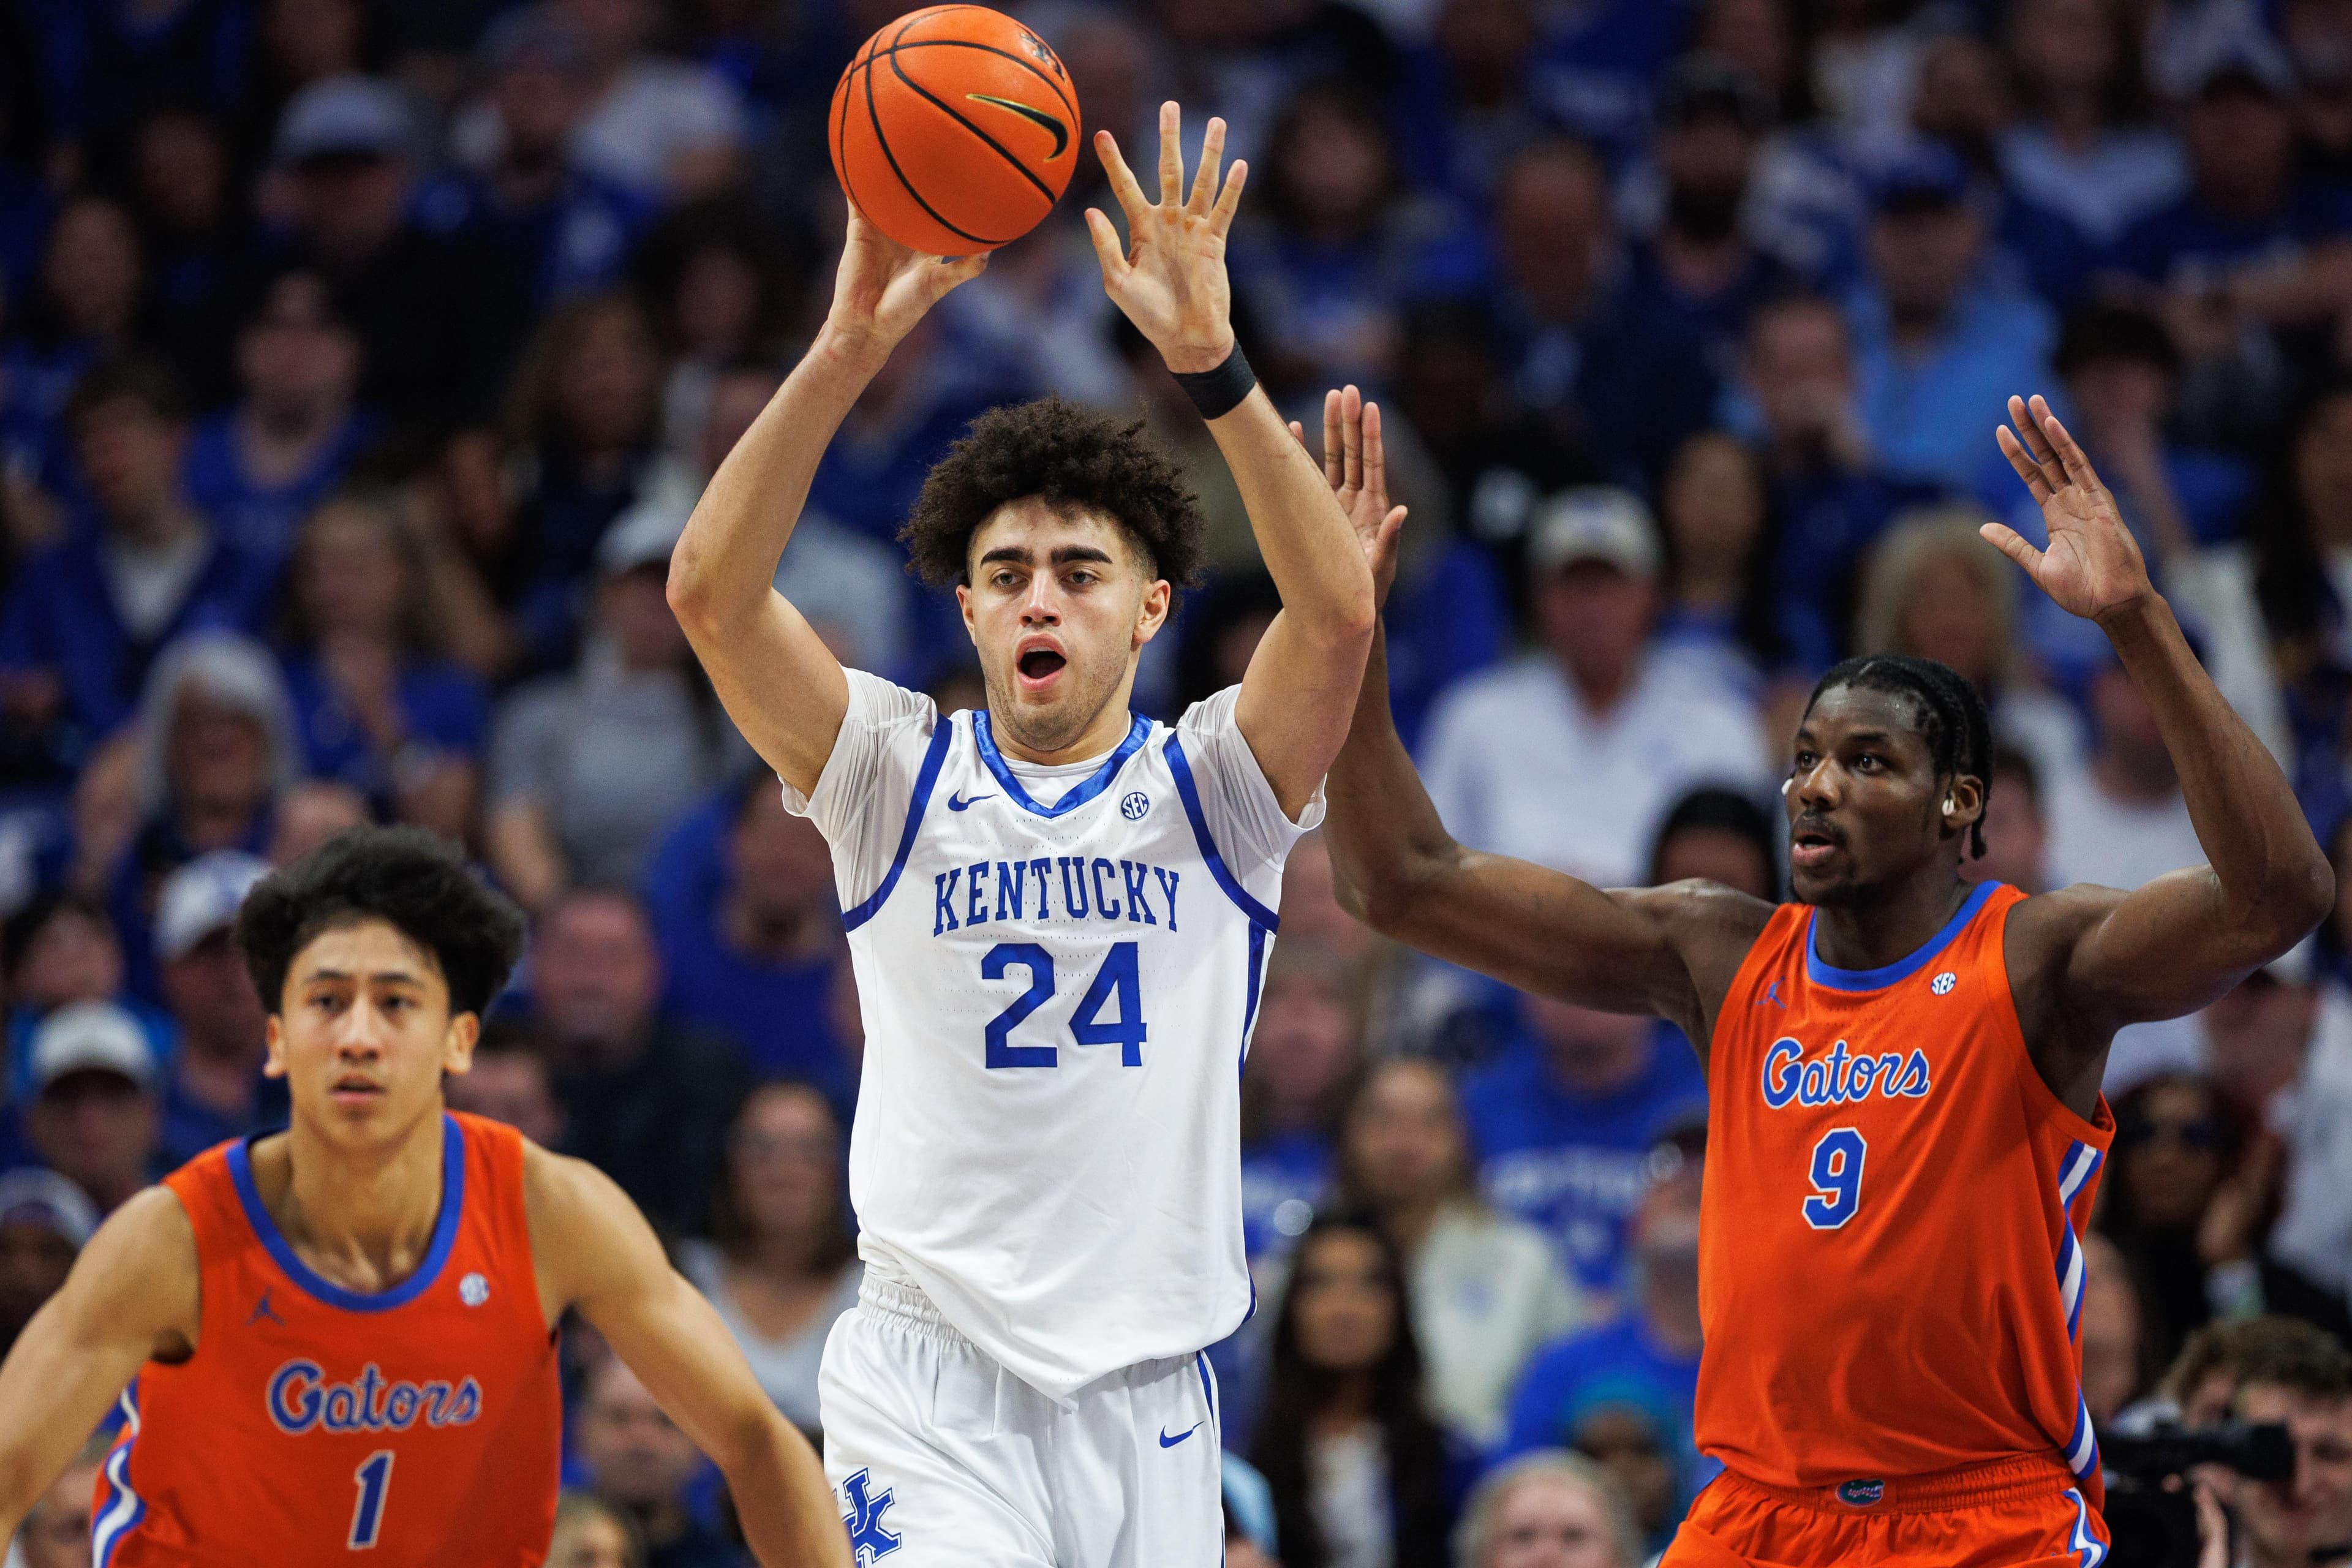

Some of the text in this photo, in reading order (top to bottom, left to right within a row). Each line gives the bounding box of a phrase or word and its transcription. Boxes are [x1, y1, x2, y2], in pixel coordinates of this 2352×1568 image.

[1121, 793, 1148, 819] SEC
[933, 856, 1179, 937] KENTUCKY
[981, 941, 1147, 1069] 24
[1931, 971, 1957, 995] SEC
[1762, 1036, 1931, 1109] Gators
[1802, 1127, 1867, 1229] 9
[266, 1359, 482, 1434] Gators
[347, 1450, 394, 1550] 1
